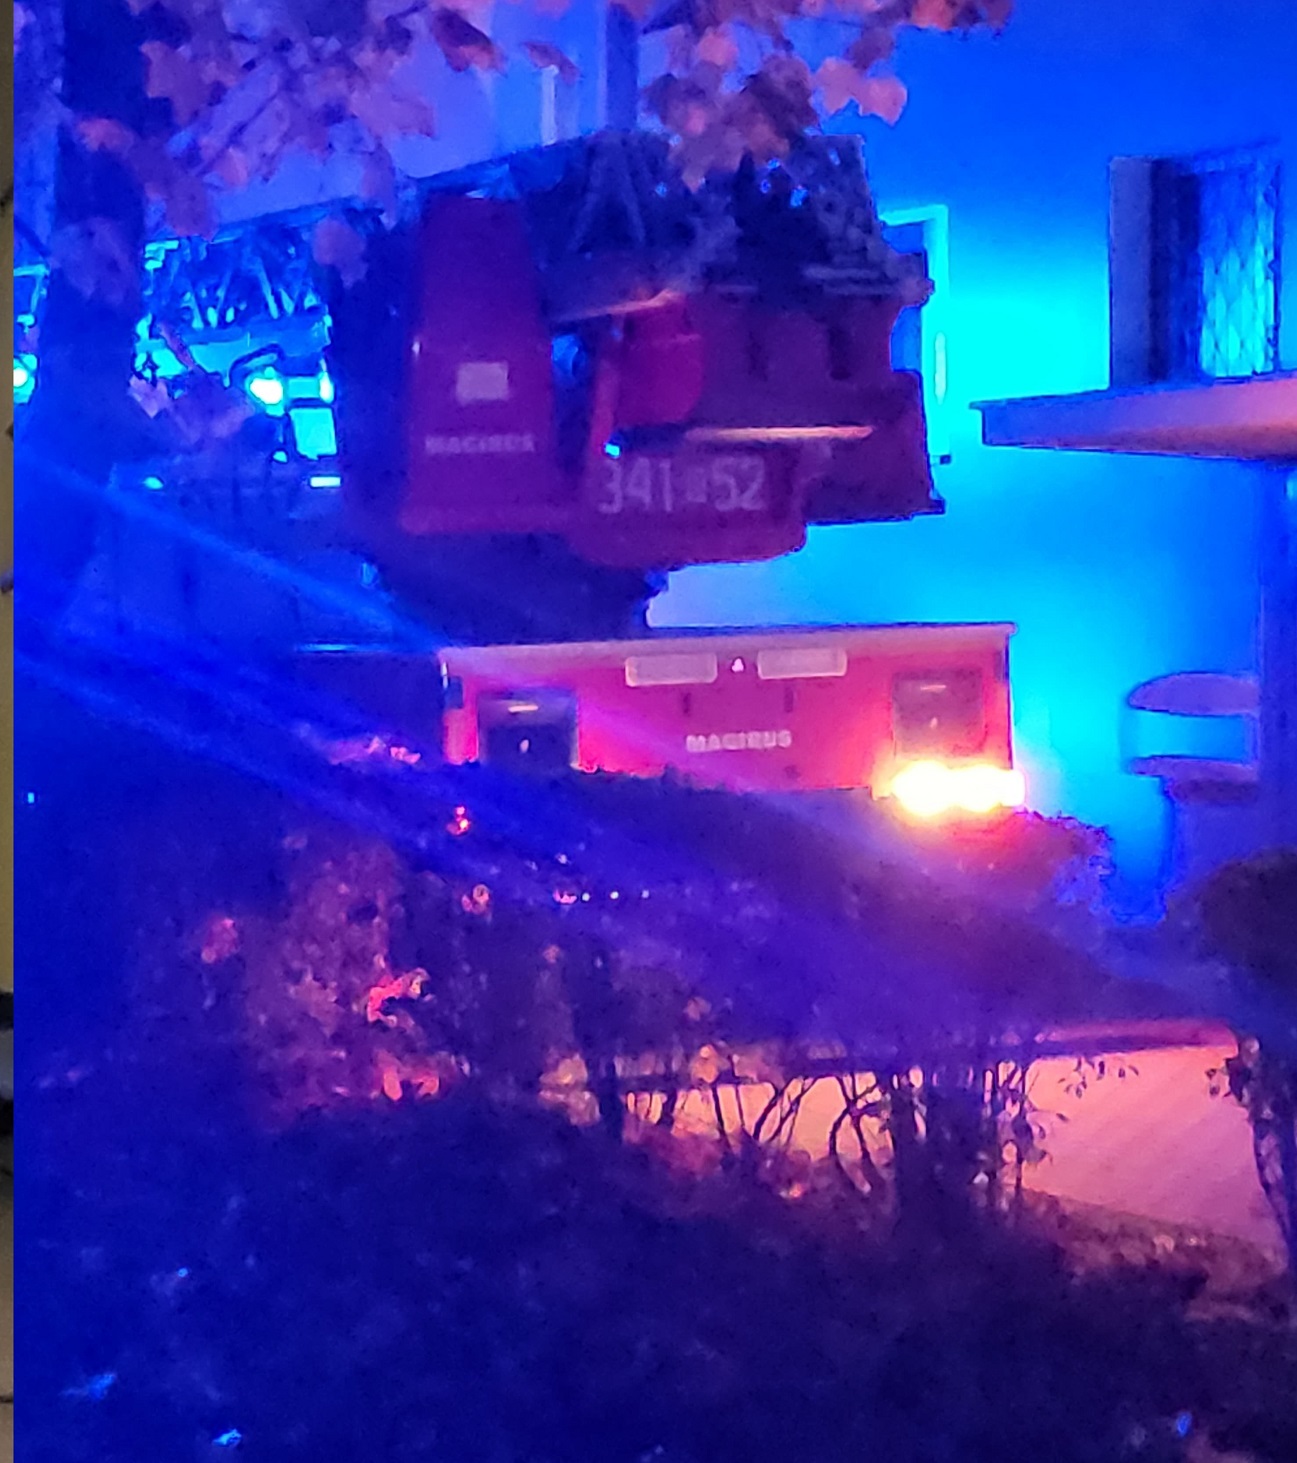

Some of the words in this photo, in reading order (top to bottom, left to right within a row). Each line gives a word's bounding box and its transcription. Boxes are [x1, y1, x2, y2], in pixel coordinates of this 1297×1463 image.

[597, 456, 673, 513] 341
[712, 456, 767, 512] 52
[686, 729, 792, 752] MAGIRUS
